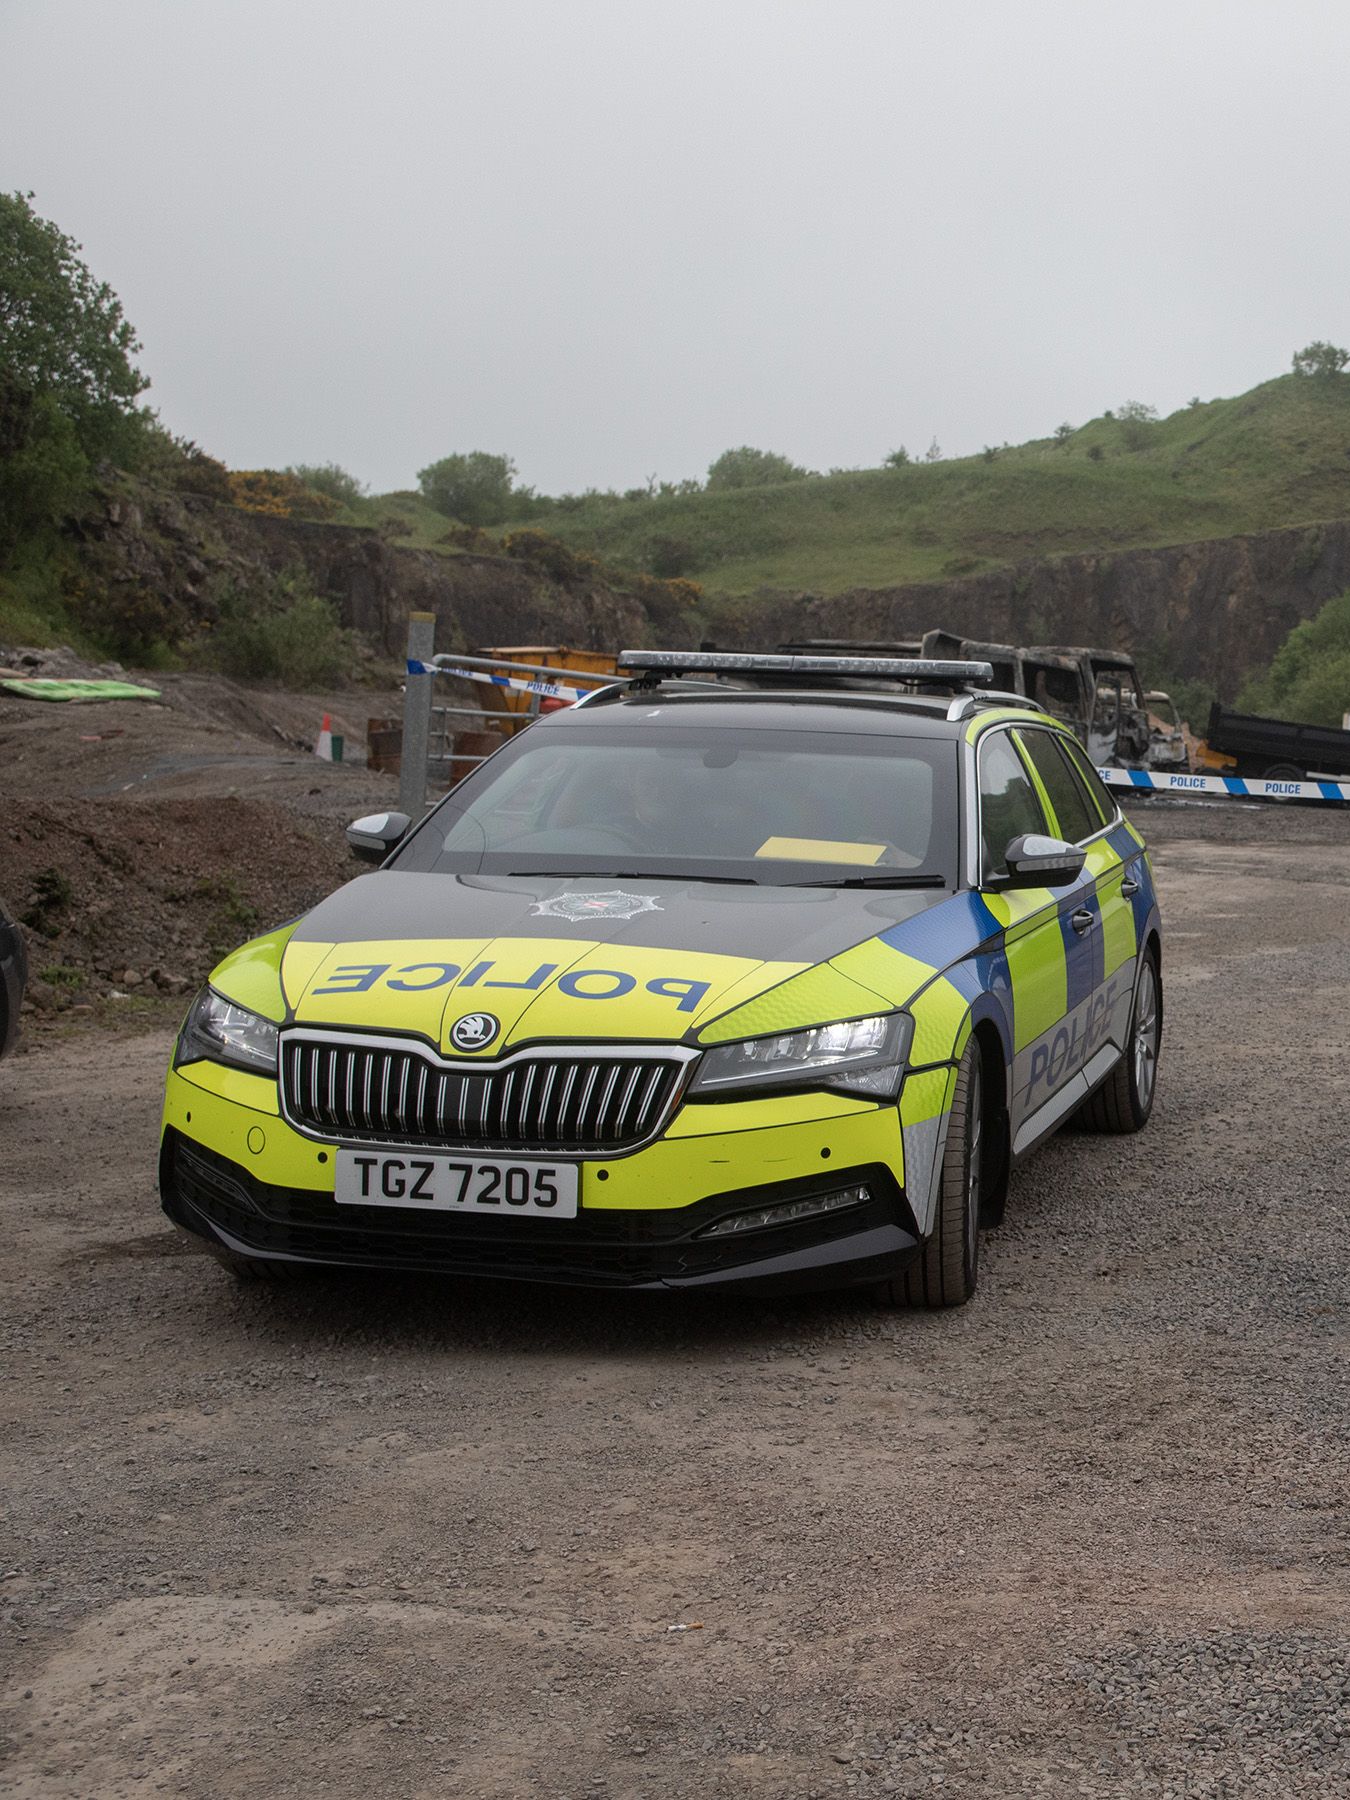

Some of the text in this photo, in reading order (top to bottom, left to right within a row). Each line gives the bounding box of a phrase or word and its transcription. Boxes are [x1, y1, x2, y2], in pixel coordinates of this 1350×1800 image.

[1170, 776, 1206, 789] POLICE
[1265, 783, 1300, 795] POLICE
[1024, 981, 1118, 1107] POLICE
[354, 1157, 559, 1209] TGZ 7205
